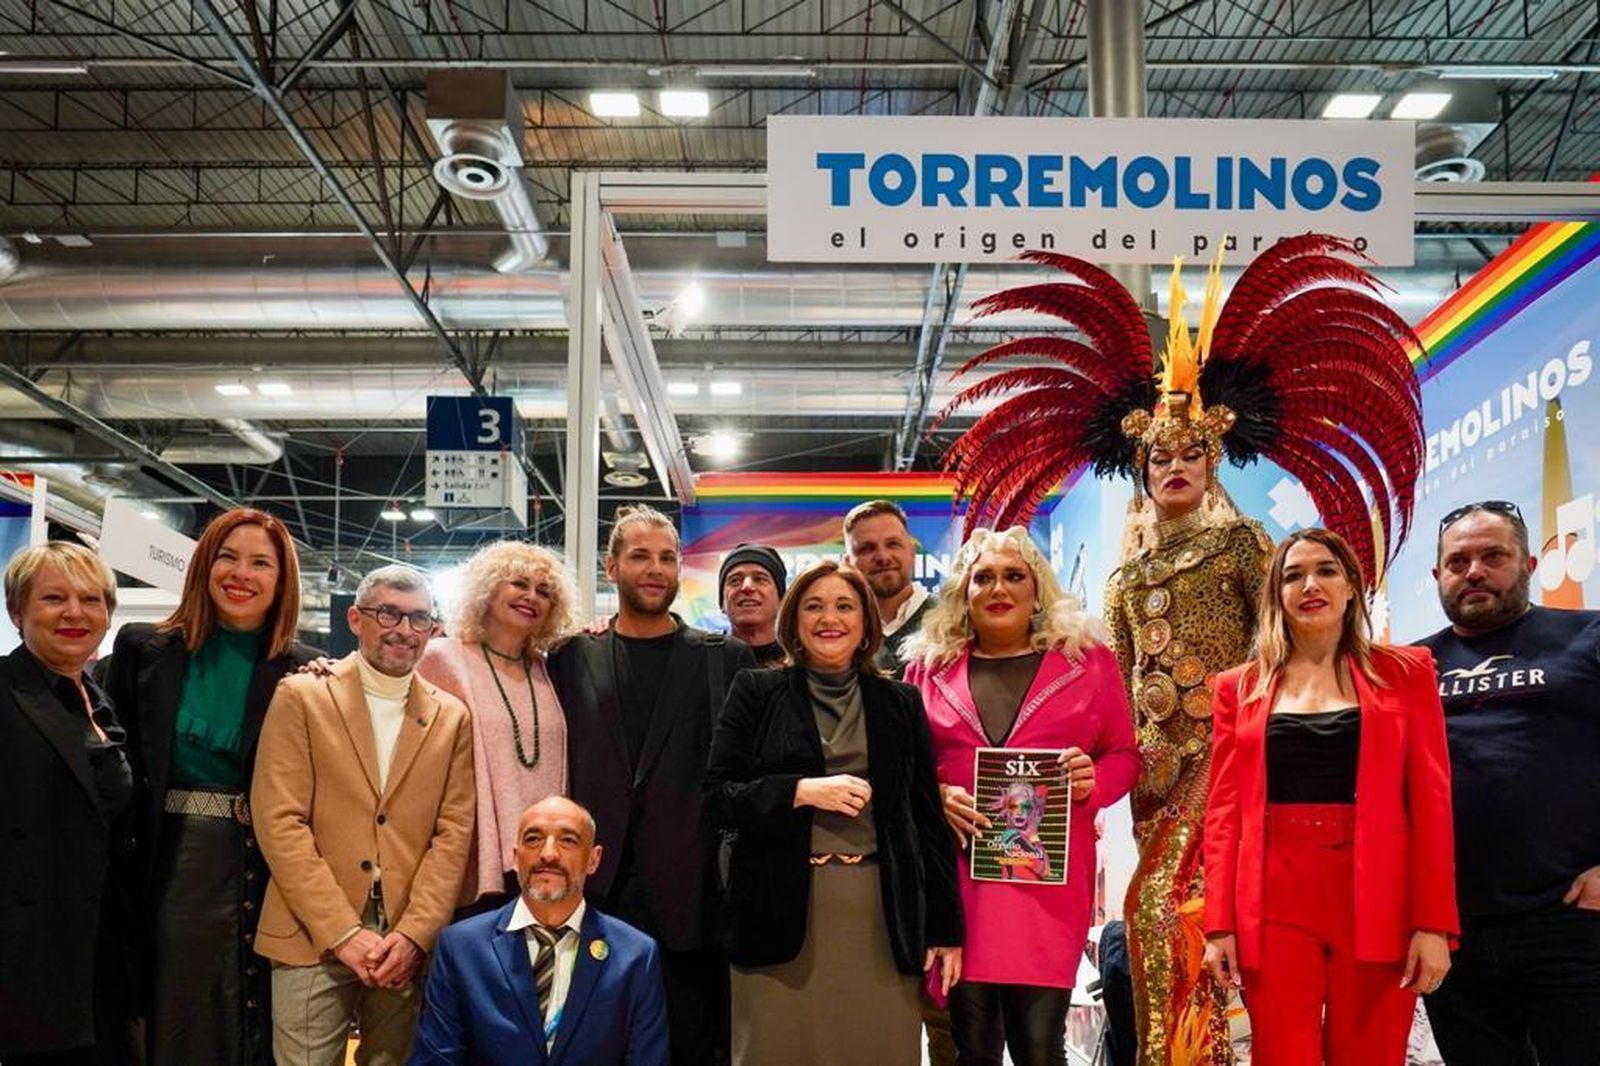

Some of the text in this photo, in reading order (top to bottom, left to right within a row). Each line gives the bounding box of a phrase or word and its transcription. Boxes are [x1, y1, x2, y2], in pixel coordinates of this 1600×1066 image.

[816, 152, 1383, 213] TORREMOLINOS
[830, 226, 866, 249] el
[903, 226, 1055, 254] origen
[1092, 228, 1157, 251] del
[1418, 340, 1593, 478] EMOLINOS
[477, 408, 500, 444] 3
[1438, 668, 1546, 697] LLISTER
[1004, 754, 1041, 776] six
